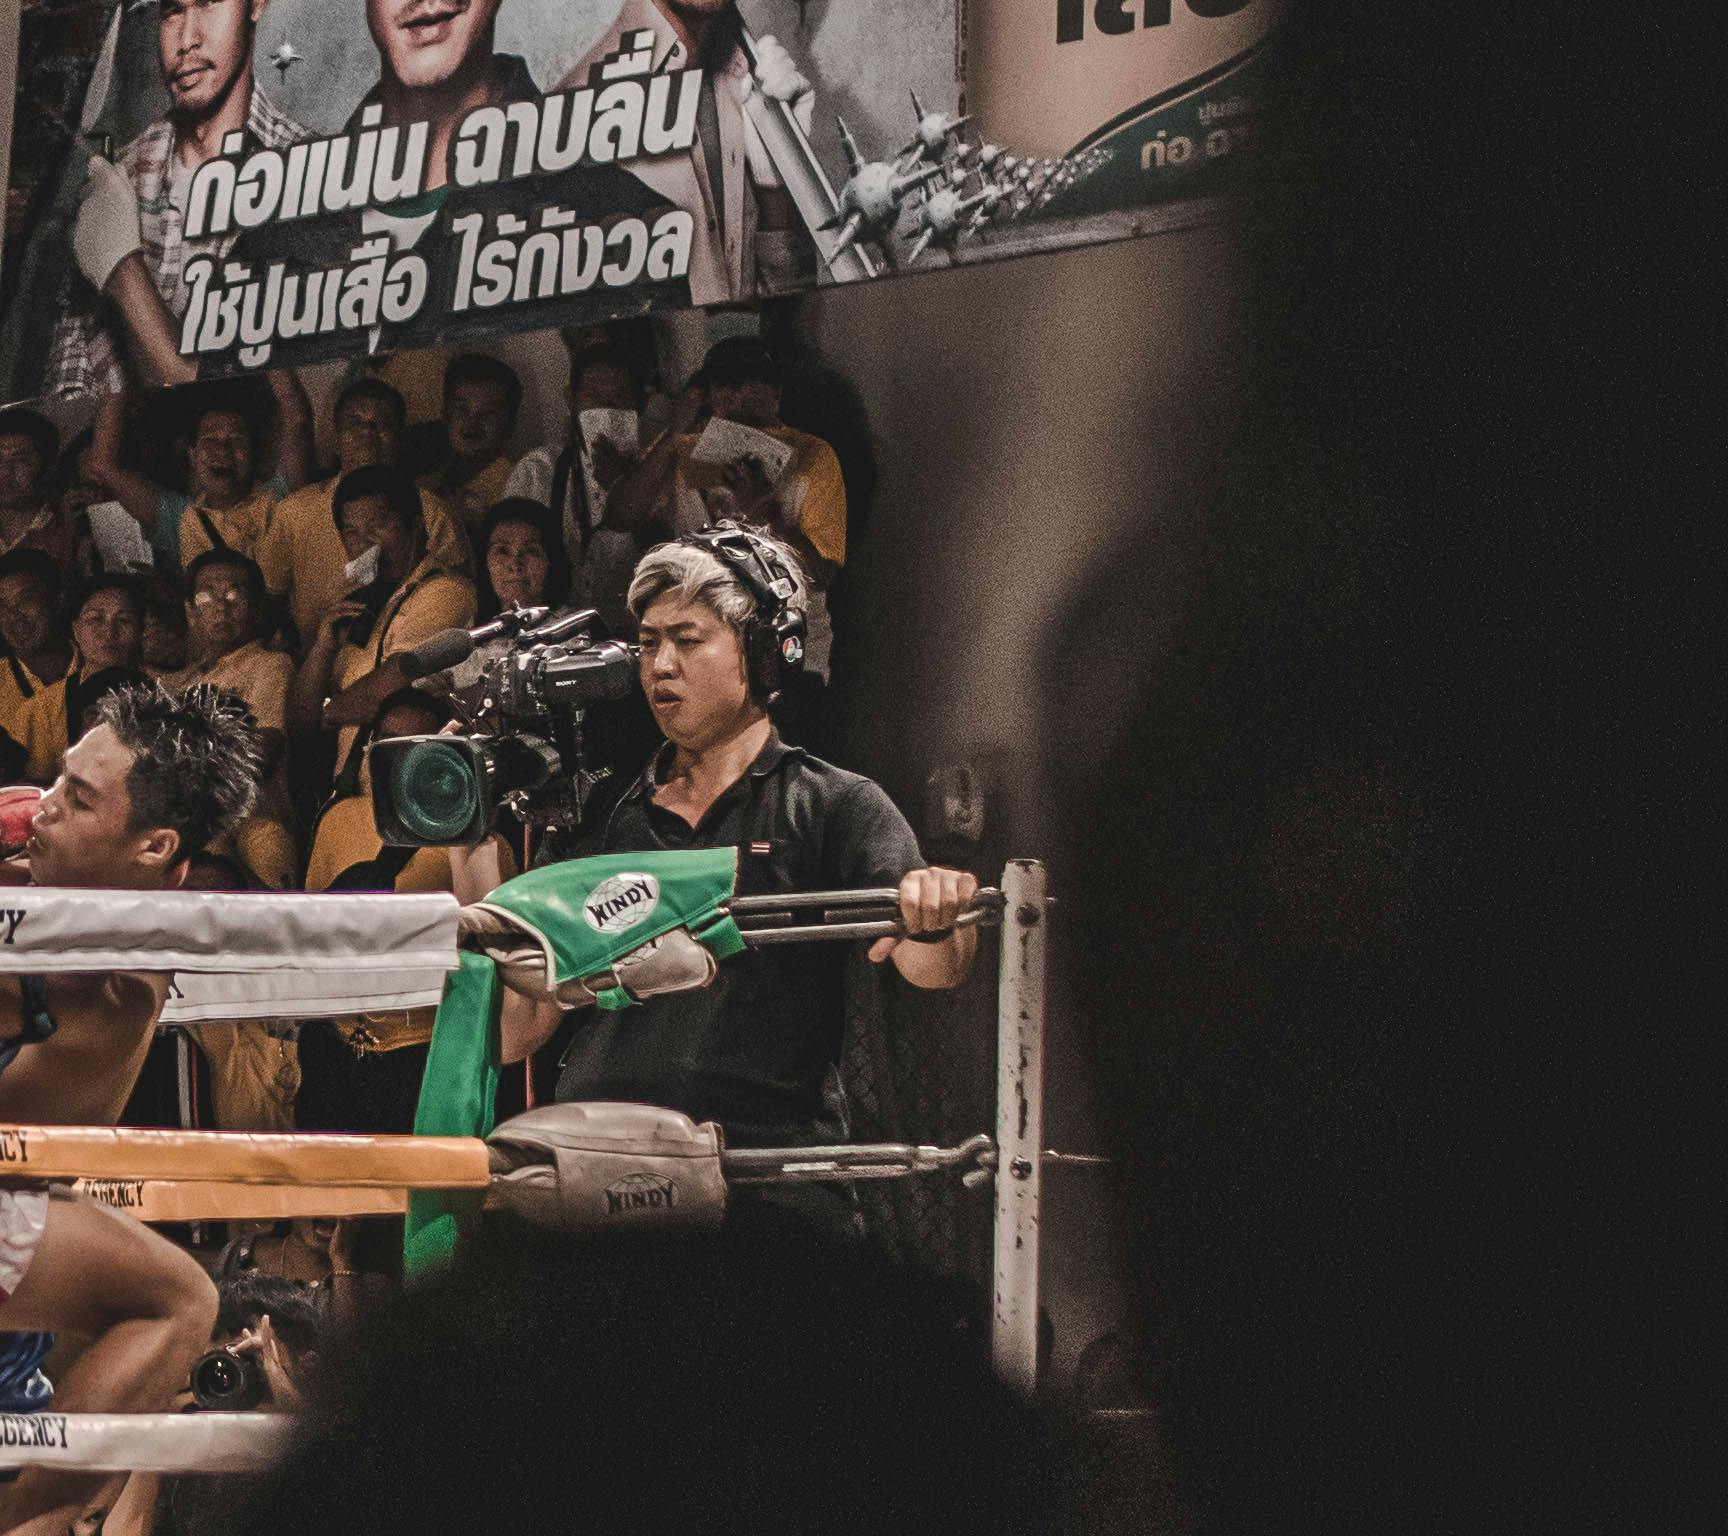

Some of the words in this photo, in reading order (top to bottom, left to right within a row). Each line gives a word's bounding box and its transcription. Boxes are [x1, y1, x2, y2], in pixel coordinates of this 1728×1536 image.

[183, 105, 432, 239] ก่อแน่น
[451, 30, 706, 187] ฉาบลื่น
[1140, 129, 1193, 170] ก่อ
[179, 237, 428, 368] ใช้ปูนเสือ
[451, 206, 695, 313] ไร้กังวล
[586, 880, 653, 927] WINDY
[605, 1179, 674, 1214] WINDY
